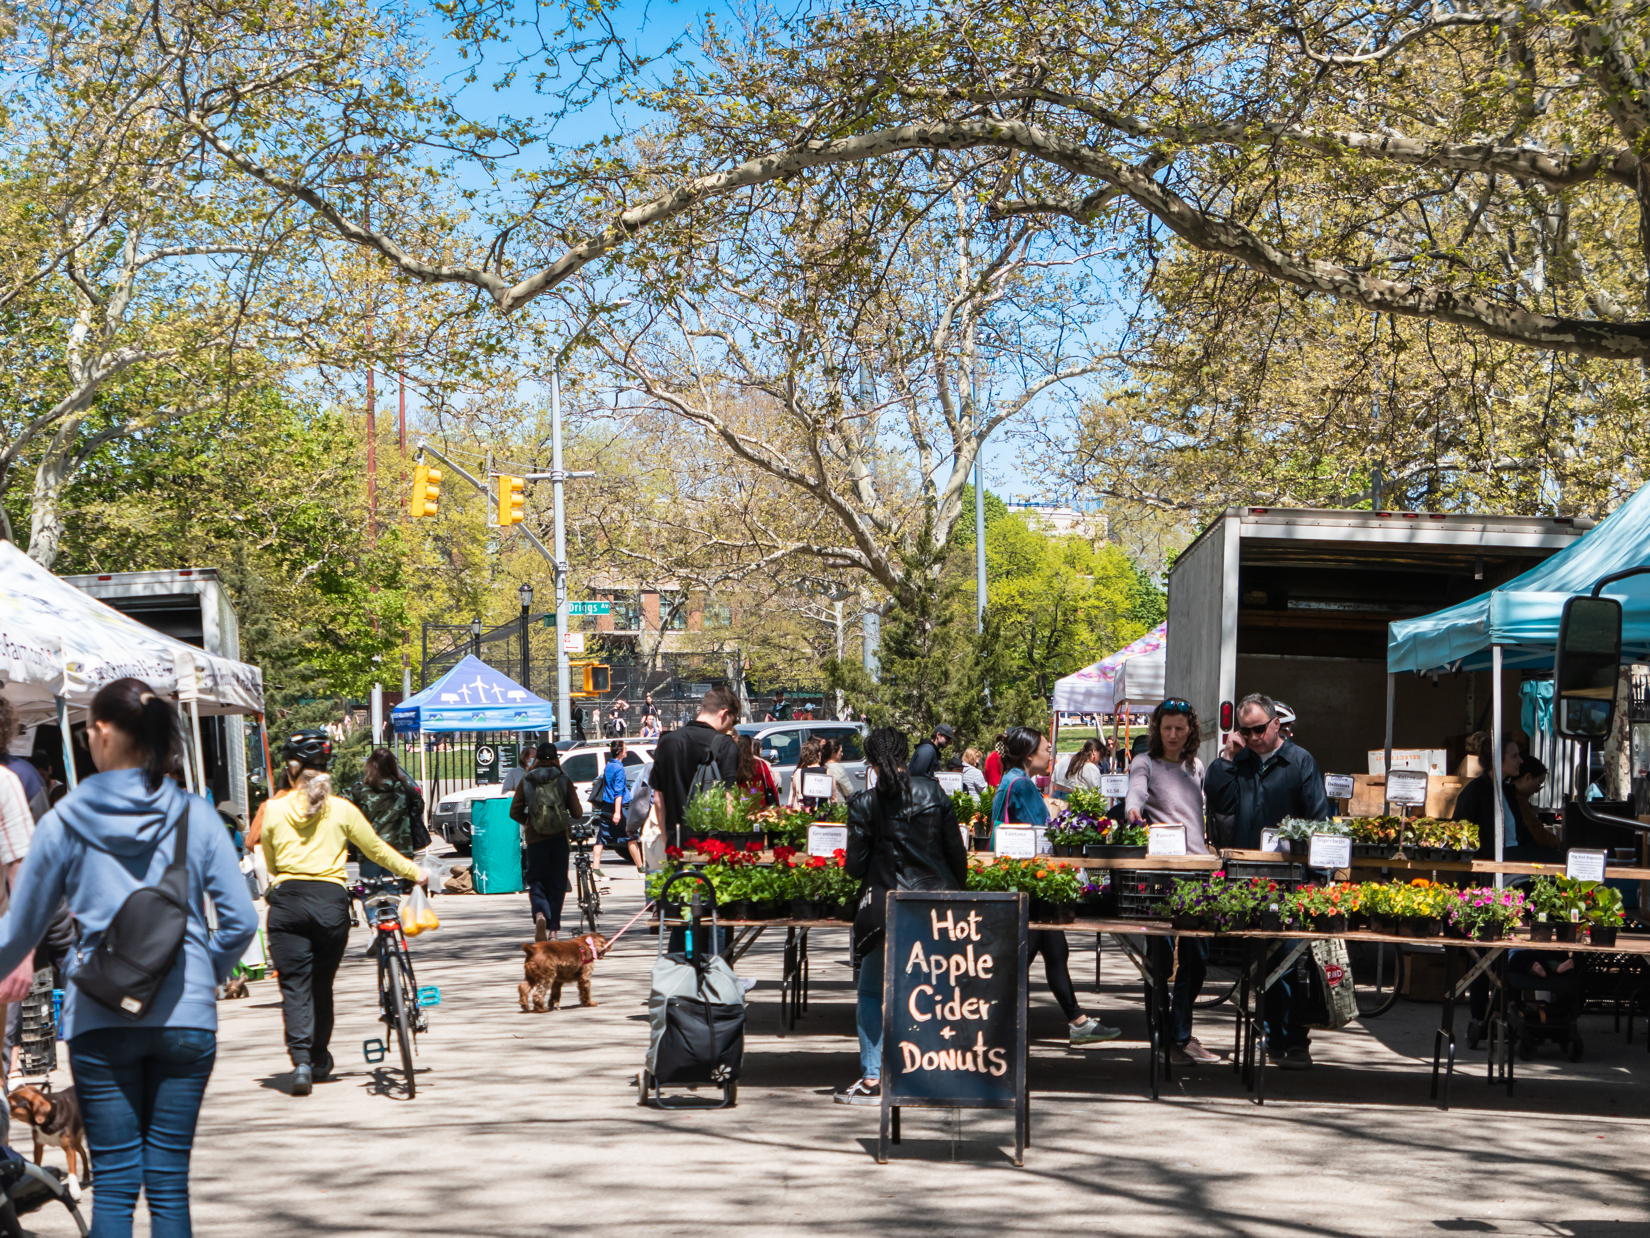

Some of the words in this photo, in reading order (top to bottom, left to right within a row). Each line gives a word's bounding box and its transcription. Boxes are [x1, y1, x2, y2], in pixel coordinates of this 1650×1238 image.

[568, 603, 598, 614] Driggs
[930, 908, 983, 942] Hot
[905, 941, 994, 986] Apple
[908, 984, 998, 1022] Cider
